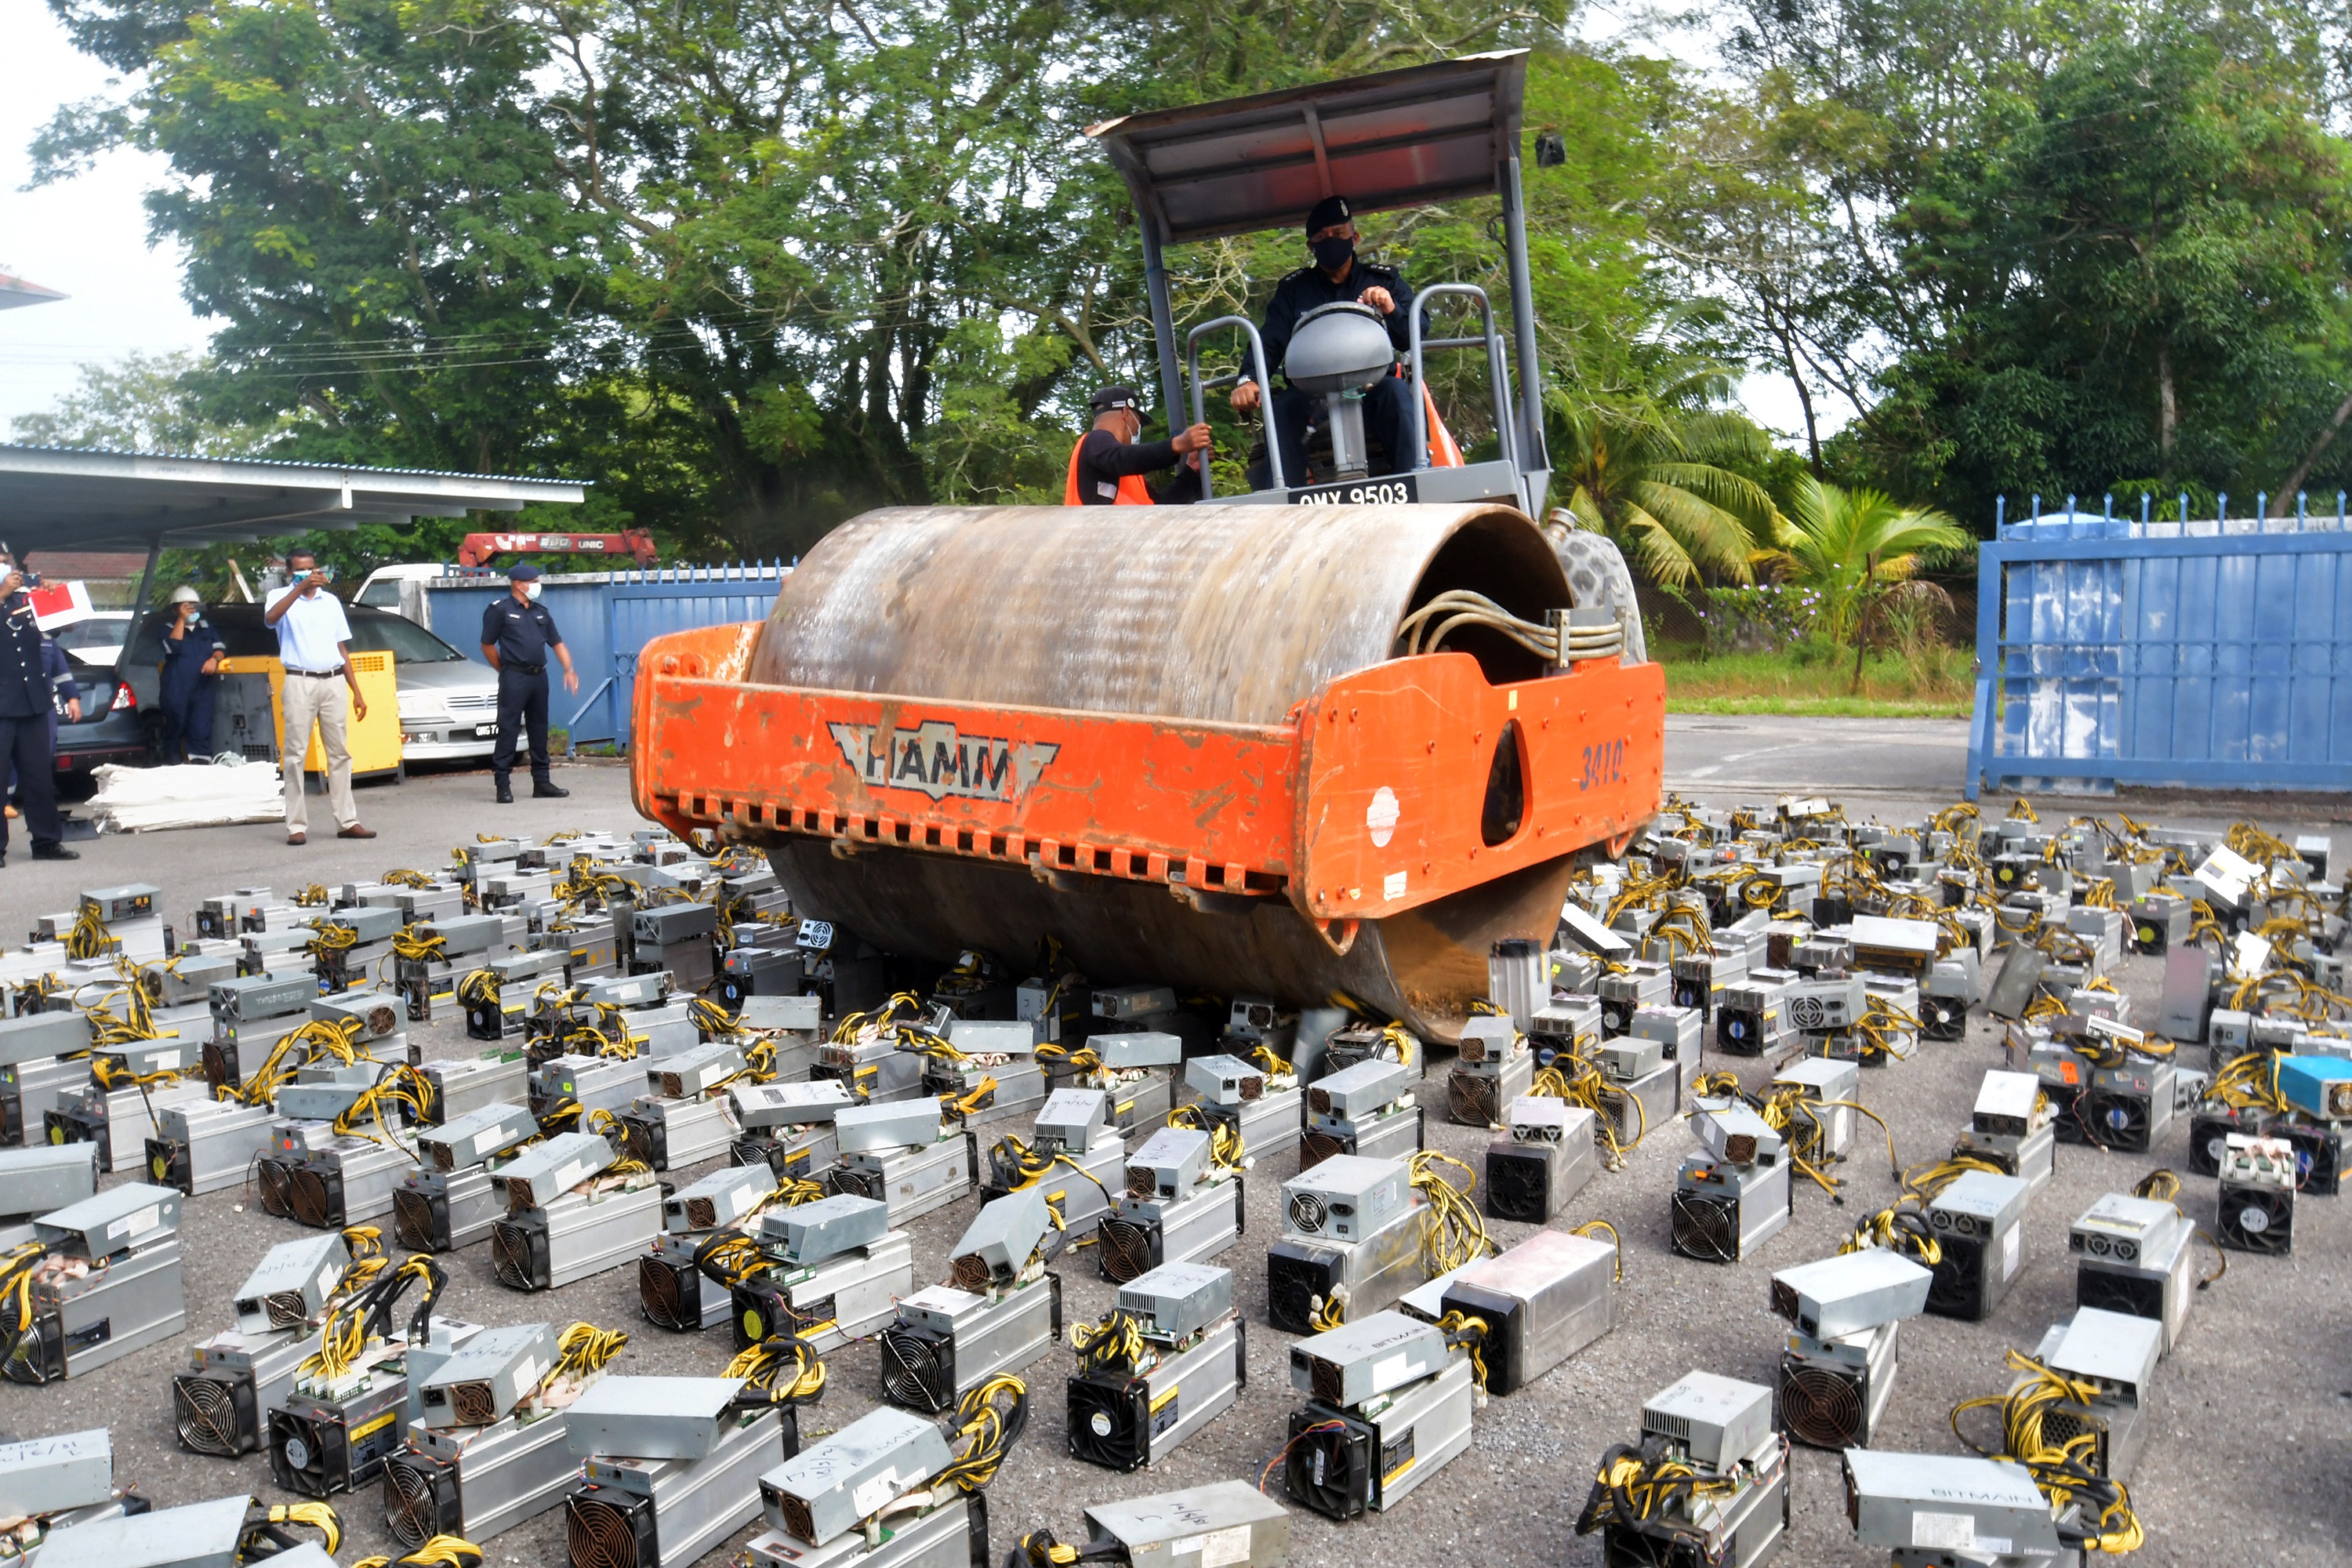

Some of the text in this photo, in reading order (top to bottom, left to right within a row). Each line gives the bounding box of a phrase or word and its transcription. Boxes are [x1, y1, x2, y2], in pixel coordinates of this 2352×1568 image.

[1350, 482, 1408, 505] 9503
[578, 540, 604, 550] UNIC
[866, 734, 1010, 791] HAMM
[1580, 739, 1623, 791] 3410
[1932, 1488, 2033, 1504] BITMAIN
